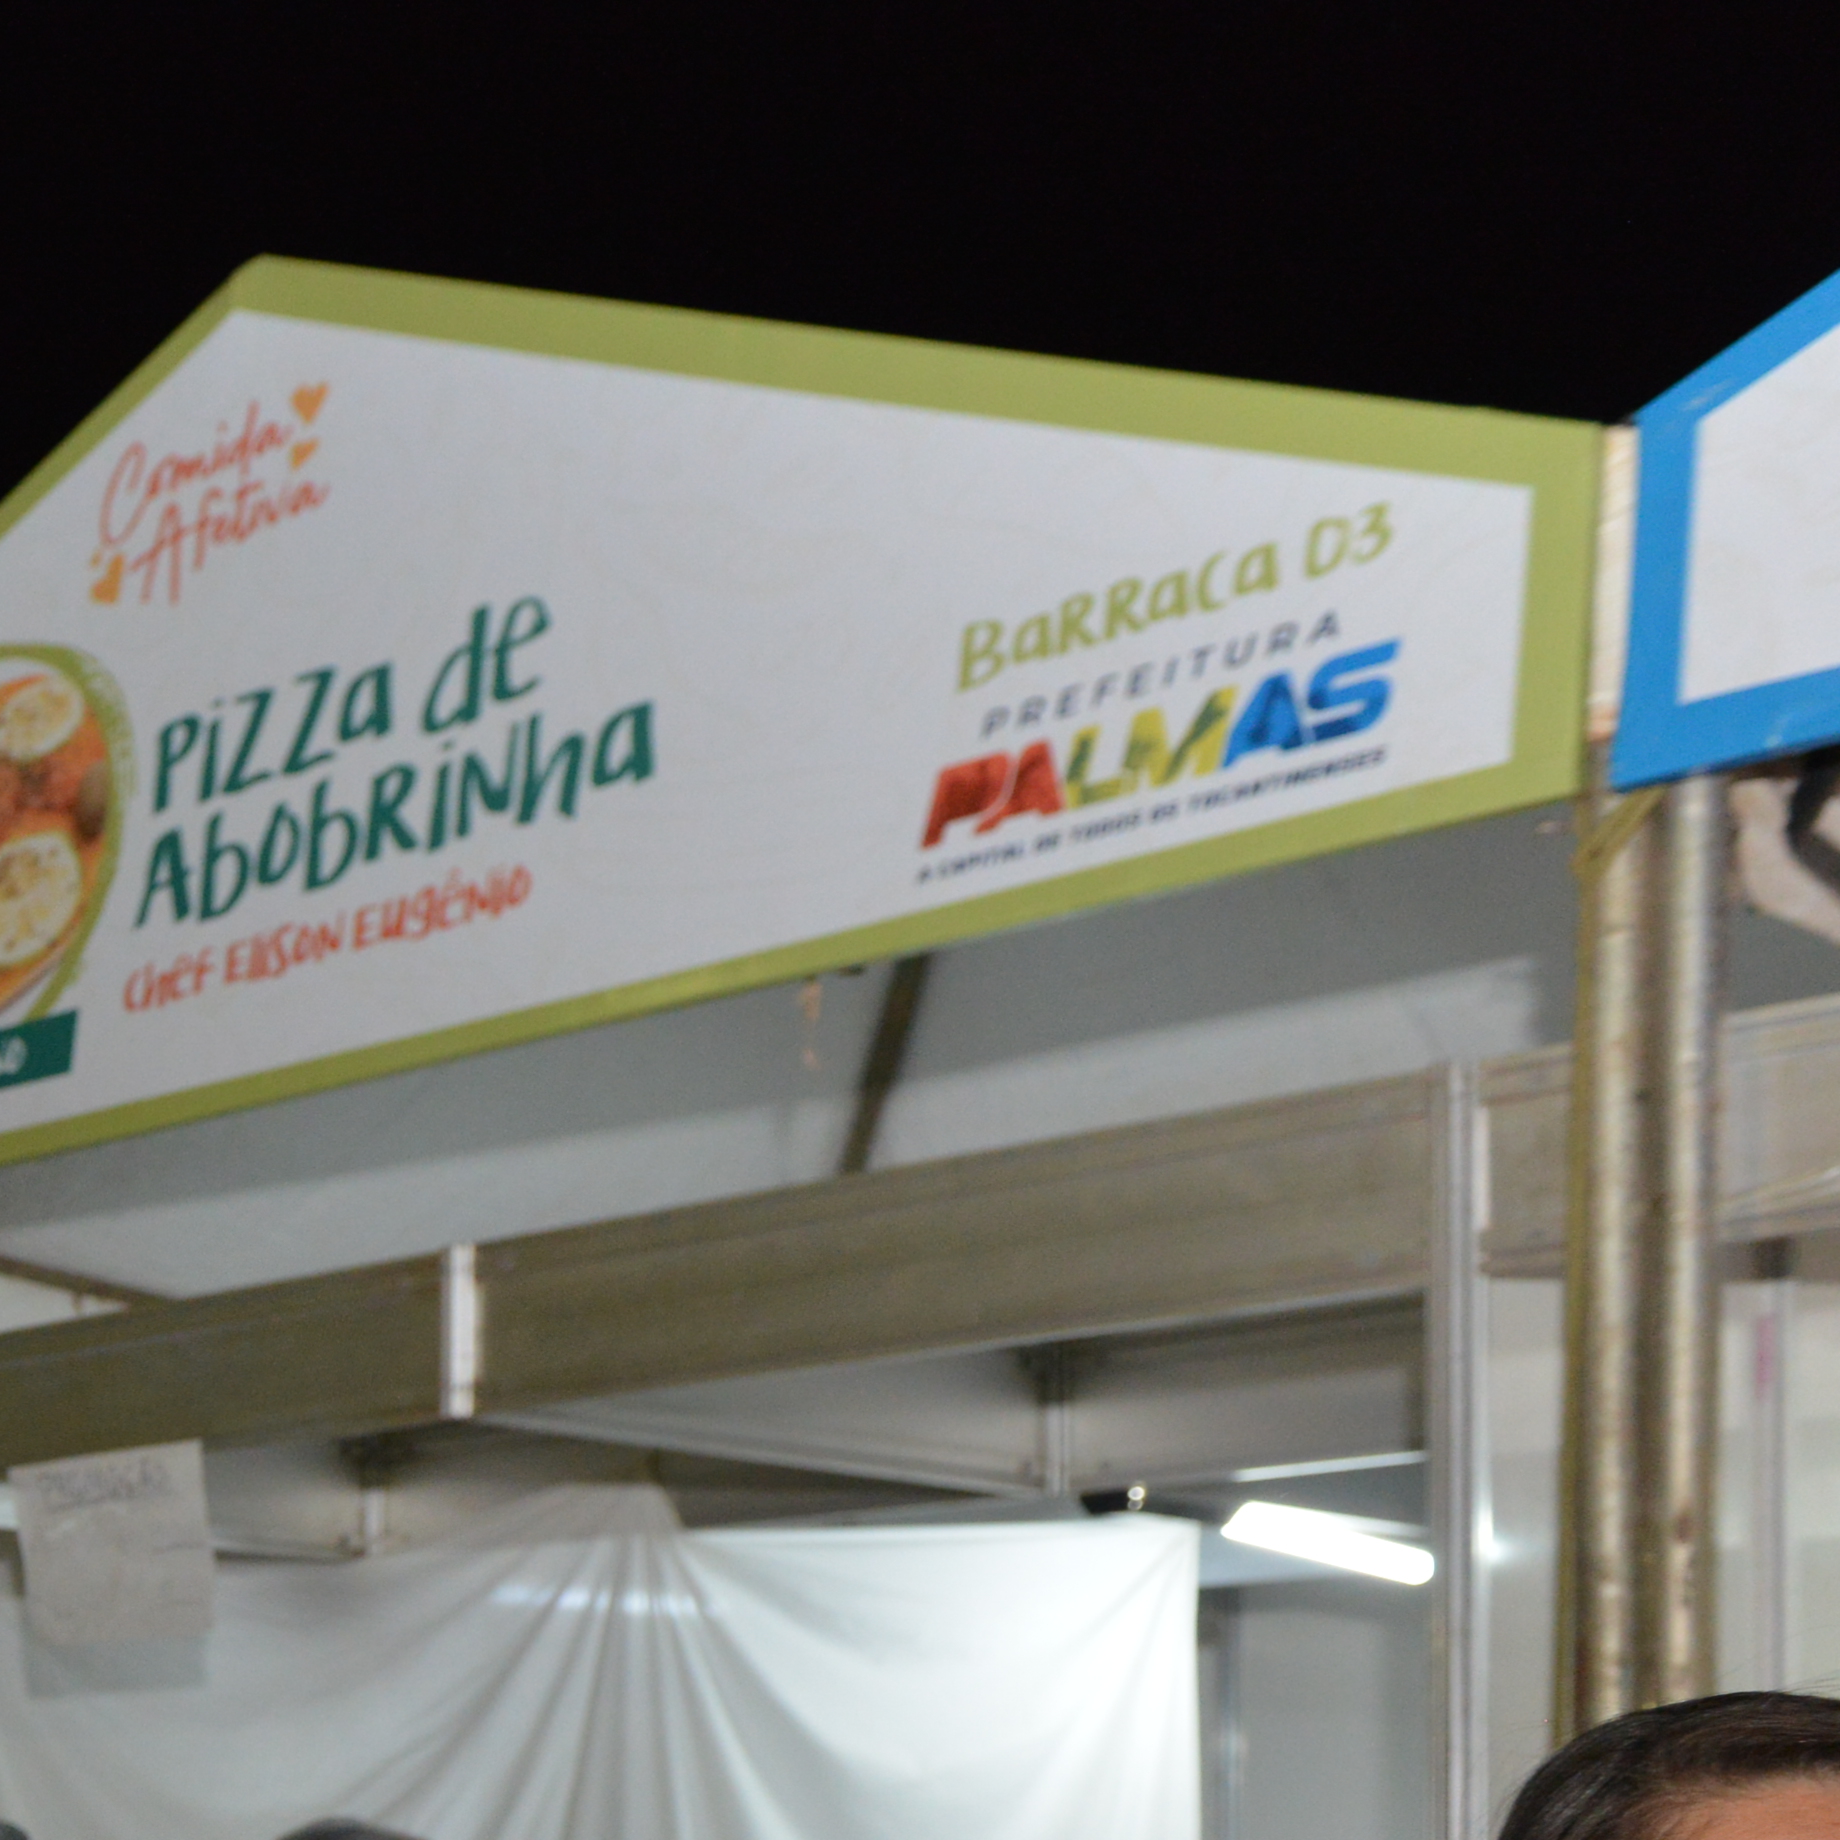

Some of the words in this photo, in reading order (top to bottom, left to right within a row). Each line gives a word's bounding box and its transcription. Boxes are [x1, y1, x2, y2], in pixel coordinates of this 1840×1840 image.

[98, 398, 294, 548] Comida
[128, 480, 330, 606] Afetiva
[421, 597, 552, 735] de
[980, 611, 1341, 740] PREFEITURA
[920, 636, 1403, 849] PALMAS
